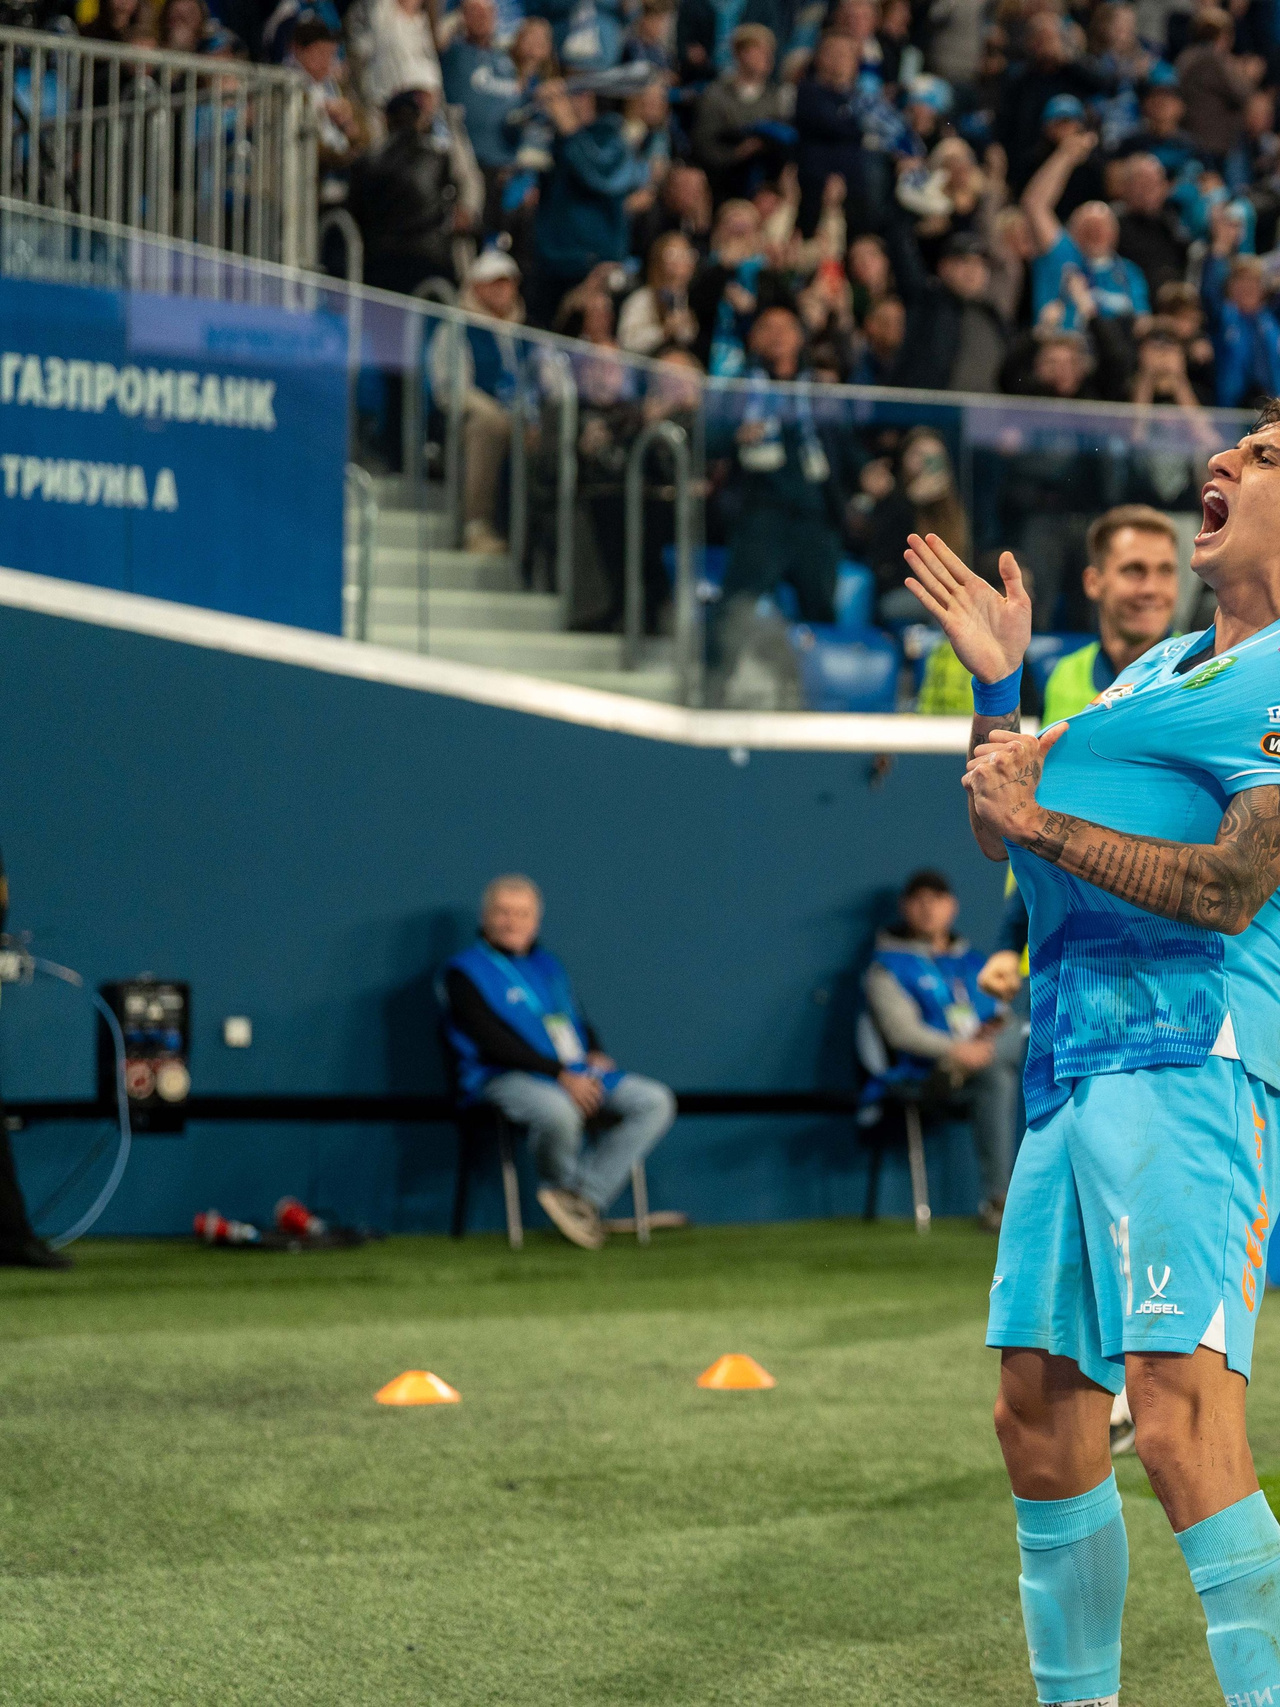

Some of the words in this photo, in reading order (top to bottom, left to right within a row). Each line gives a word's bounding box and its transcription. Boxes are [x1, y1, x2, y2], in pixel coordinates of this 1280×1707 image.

[1, 352, 276, 431] ГАЗПРОМБАНК
[1, 453, 148, 509] ТРИБУНА
[152, 466, 178, 512] А
[1135, 1300, 1184, 1315] JÖGEL
